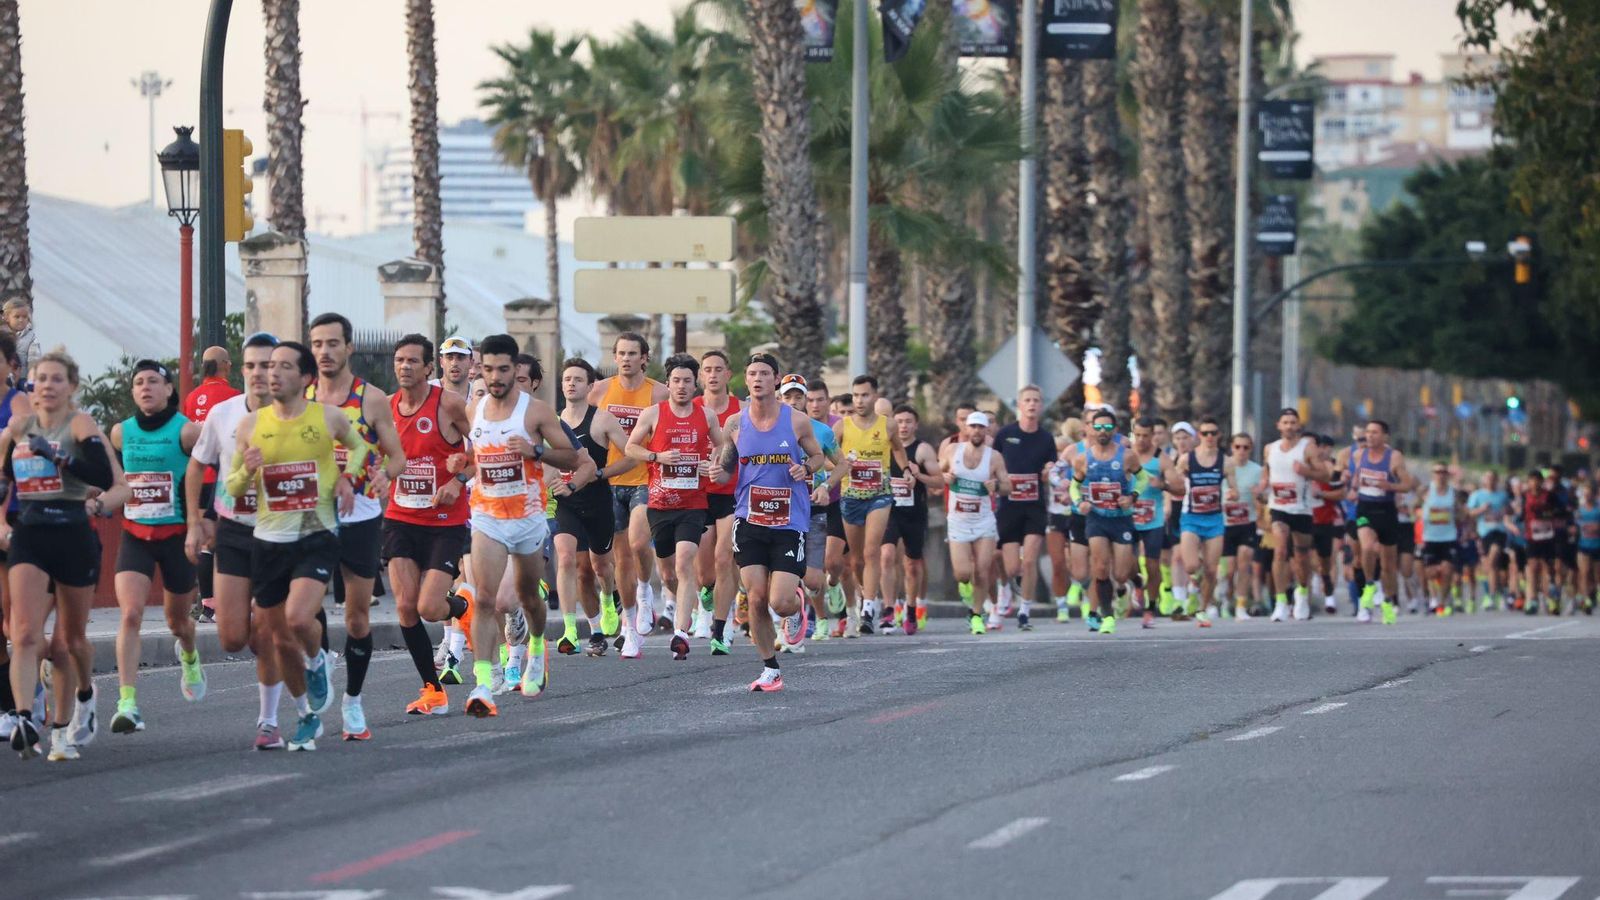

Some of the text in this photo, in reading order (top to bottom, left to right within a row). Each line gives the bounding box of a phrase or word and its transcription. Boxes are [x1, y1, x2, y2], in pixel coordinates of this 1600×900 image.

[751, 454, 767, 465] YOU
[486, 468, 515, 478] 12388
[670, 466, 692, 474] 11956
[277, 480, 304, 491] 4393
[403, 480, 426, 490] 11115
[133, 488, 162, 498] 12534
[244, 497, 257, 506] 12
[758, 501, 780, 510] 4963
